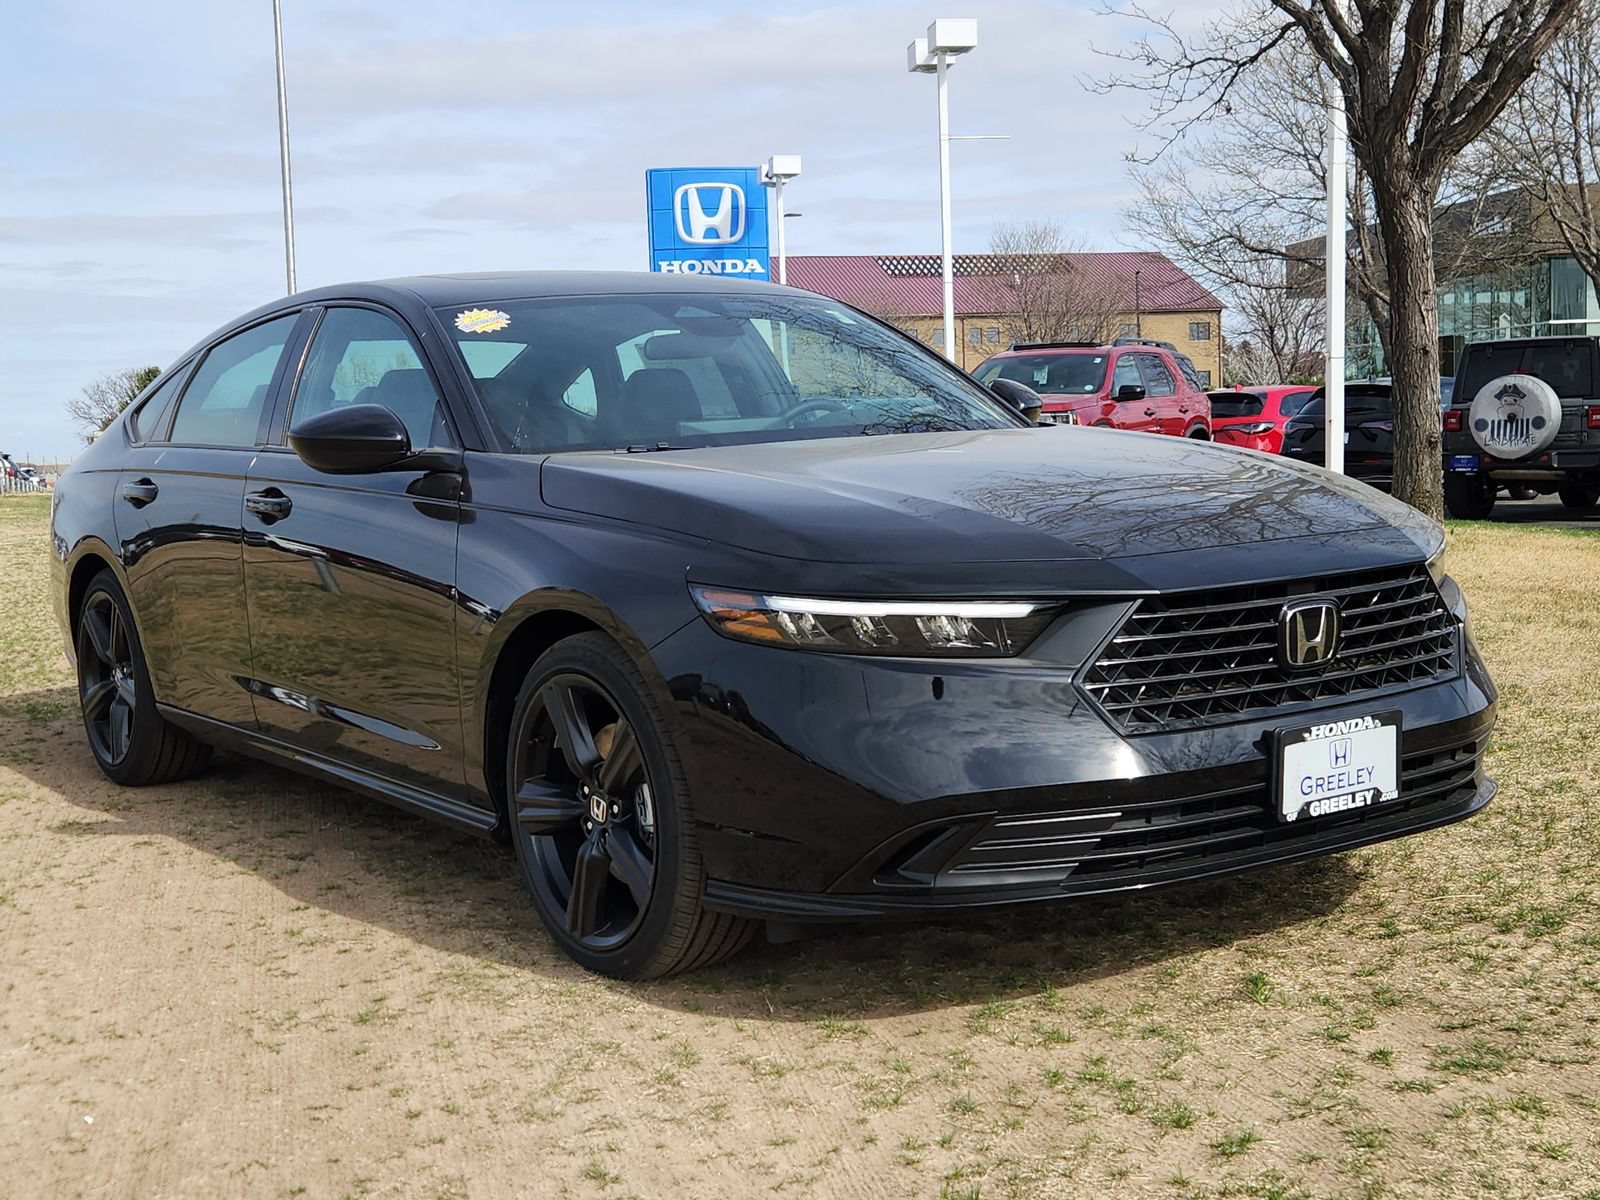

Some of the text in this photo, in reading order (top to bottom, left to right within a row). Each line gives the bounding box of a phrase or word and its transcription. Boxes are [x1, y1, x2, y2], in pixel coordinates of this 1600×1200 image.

[658, 259, 765, 274] HONDA
[1310, 716, 1375, 739] HONDA
[1300, 766, 1375, 796] GREELEY
[1286, 812, 1298, 822] OF
[1310, 790, 1375, 817] GREELEY
